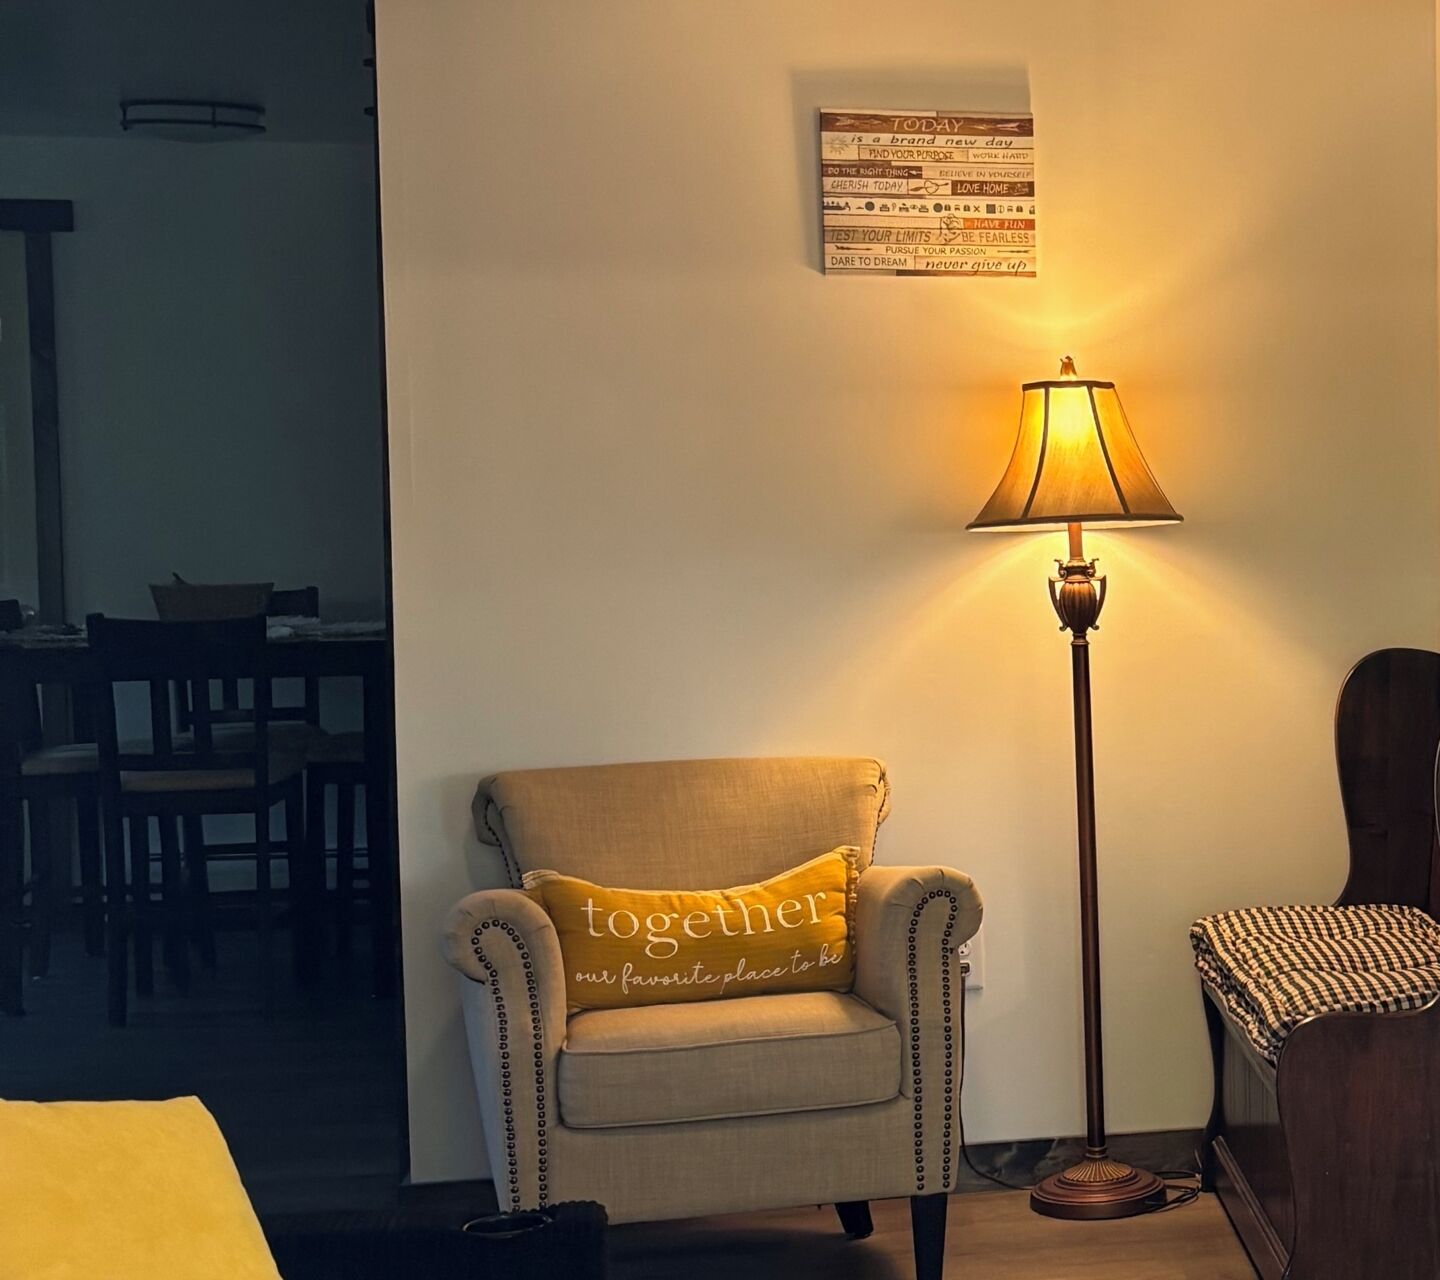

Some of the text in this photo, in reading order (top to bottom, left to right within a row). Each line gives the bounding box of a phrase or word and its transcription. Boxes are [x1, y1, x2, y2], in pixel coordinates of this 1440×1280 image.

[891, 117, 964, 133] TODAY
[851, 134, 863, 143] is
[890, 135, 937, 145] brand
[945, 138, 977, 146] new
[985, 137, 1014, 148] day
[869, 149, 955, 161] FIND YOUR PURPOSE
[972, 152, 1000, 160] WORK
[939, 170, 971, 178] BELIEVE
[988, 171, 1031, 179] YOURSELF
[831, 180, 903, 192] CHERISH TODAY
[957, 183, 1009, 194] LOVE HOME
[973, 220, 1026, 230] HAVE FUN
[830, 229, 932, 243] TEST YOUR LIMITS
[961, 231, 1030, 243] BE FEARLESS
[885, 245, 987, 256] PURSUE YOUR PASSION
[831, 256, 908, 267] DARE TO DREAM
[925, 259, 1027, 276] never give up
[580, 890, 827, 960] together
[575, 943, 844, 994] our favorite place to be
